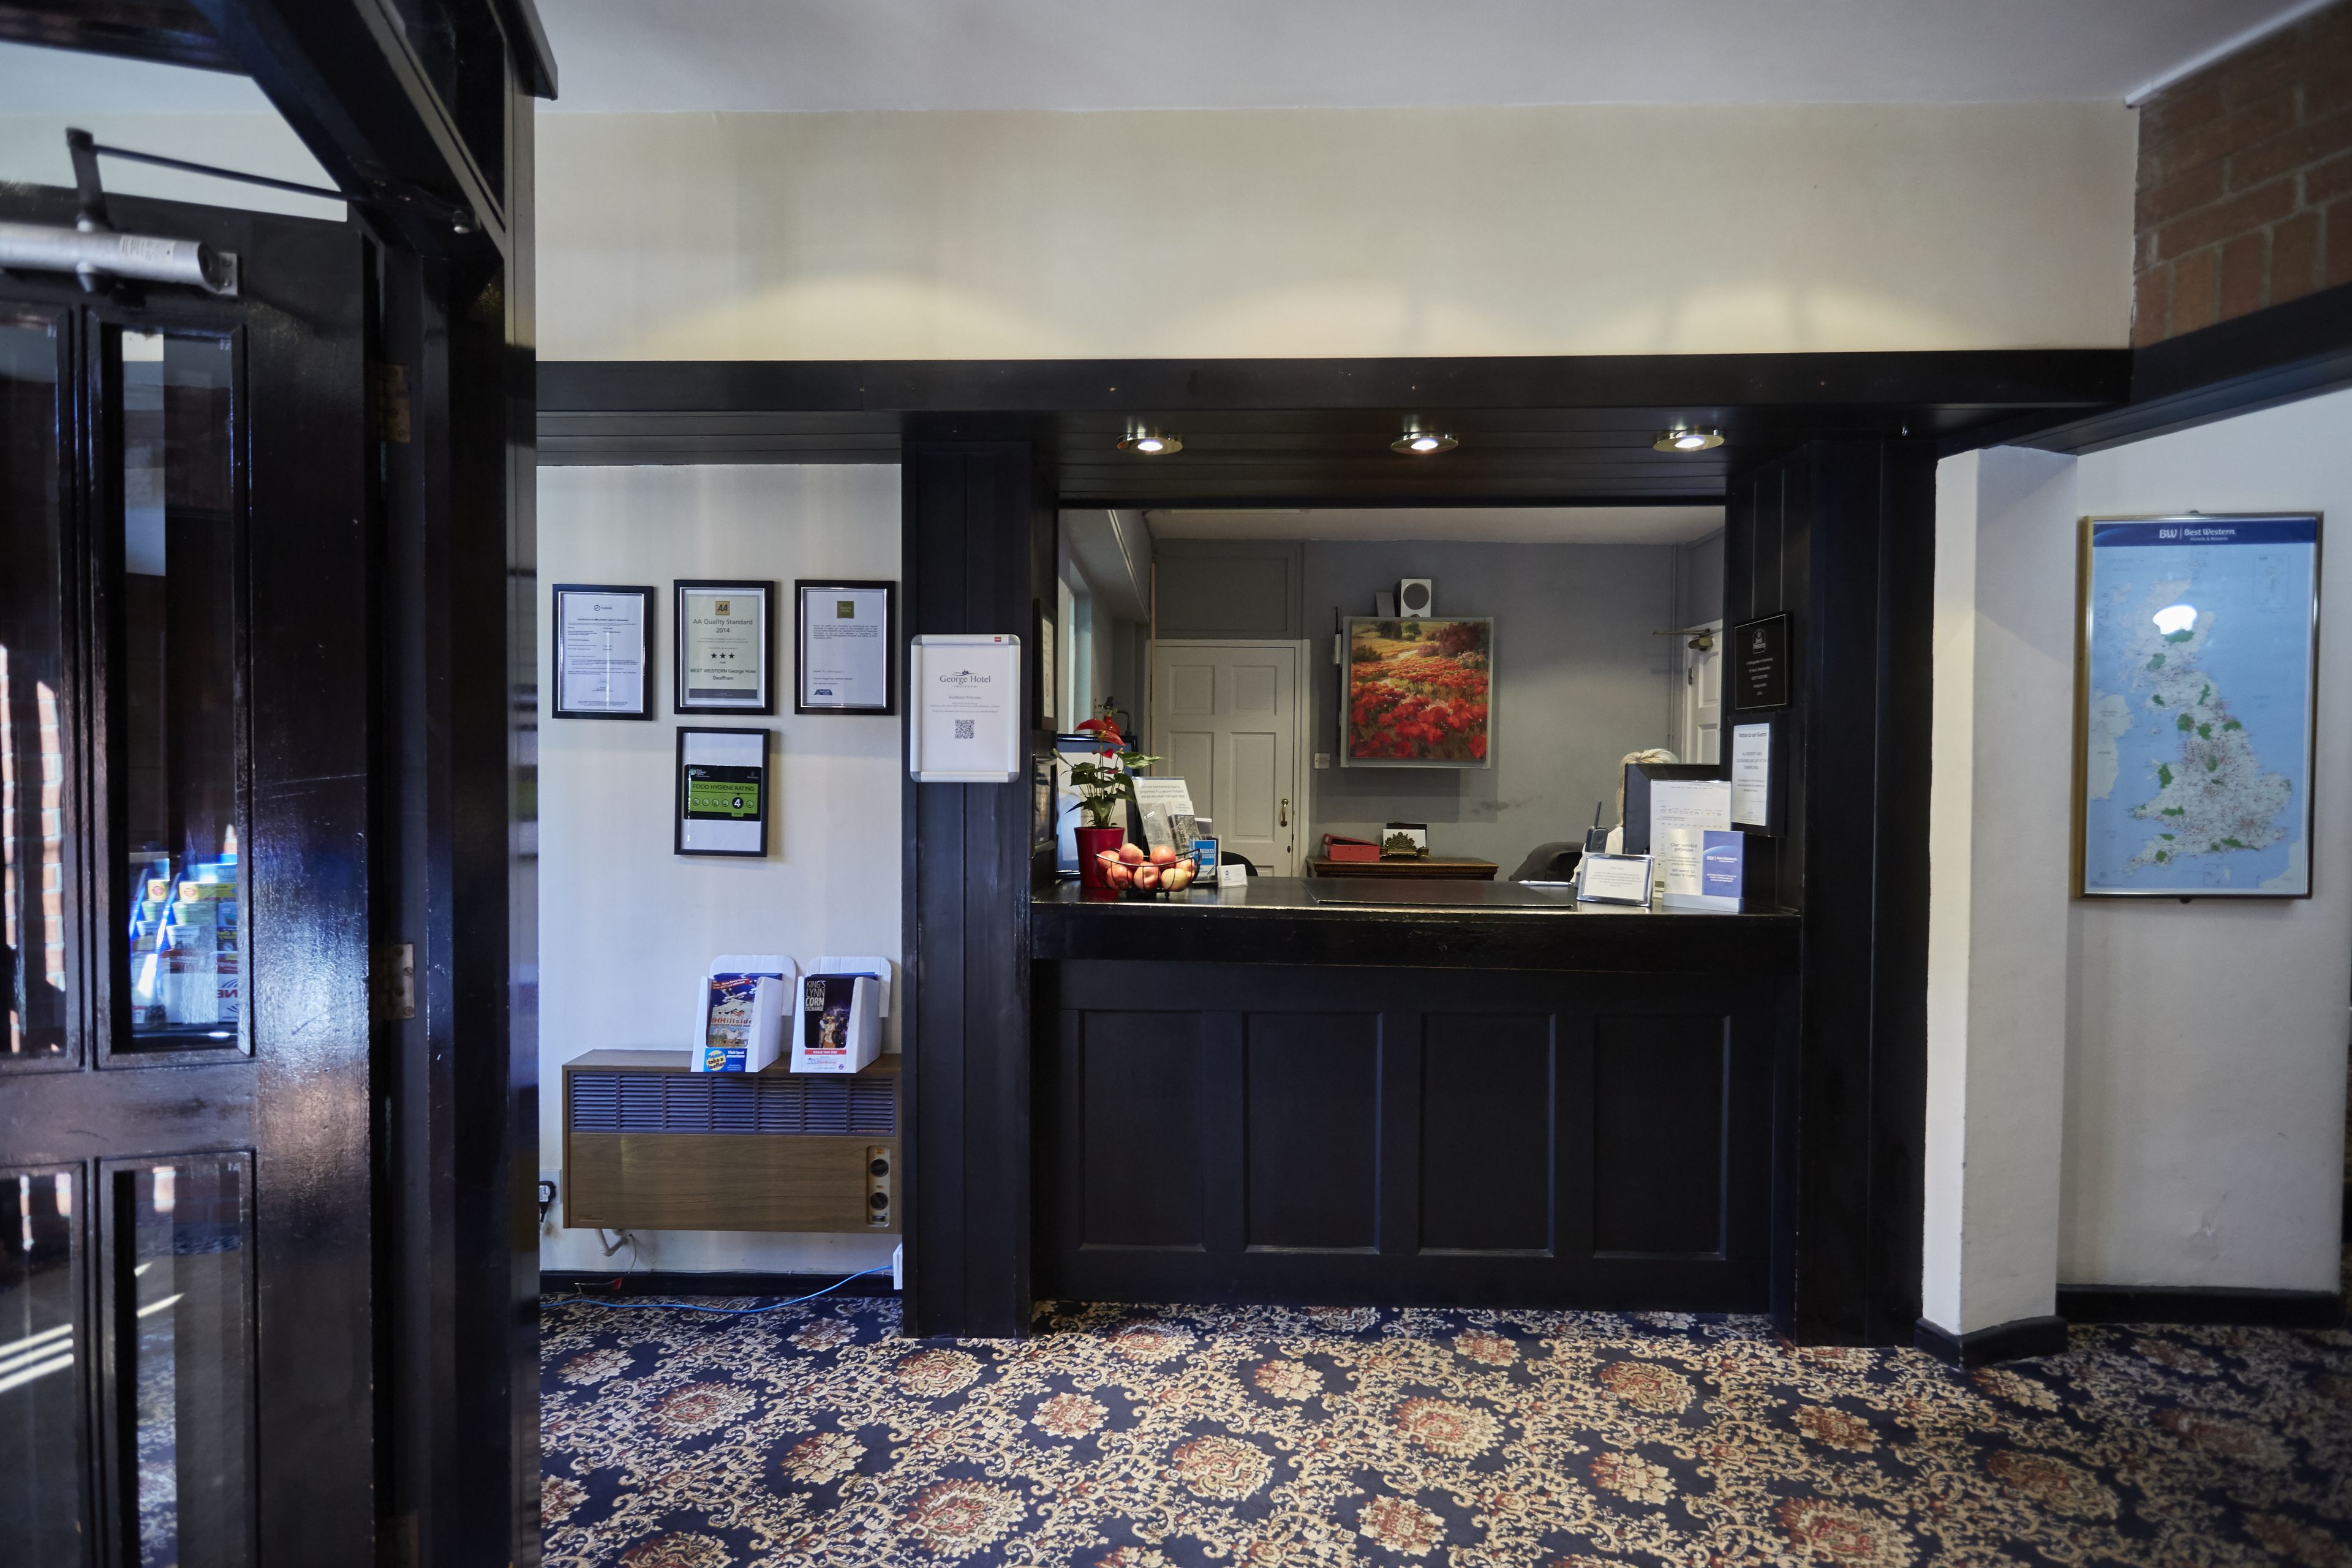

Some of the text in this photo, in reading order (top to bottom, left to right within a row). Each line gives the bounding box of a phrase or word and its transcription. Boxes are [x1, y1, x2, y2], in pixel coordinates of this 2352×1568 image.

[2159, 529, 2177, 538] BW
[940, 675, 968, 685] George
[734, 798, 741, 808] 4
[806, 980, 826, 989] KING'S
[806, 988, 826, 997] LYNN
[805, 997, 824, 1006] CORN
